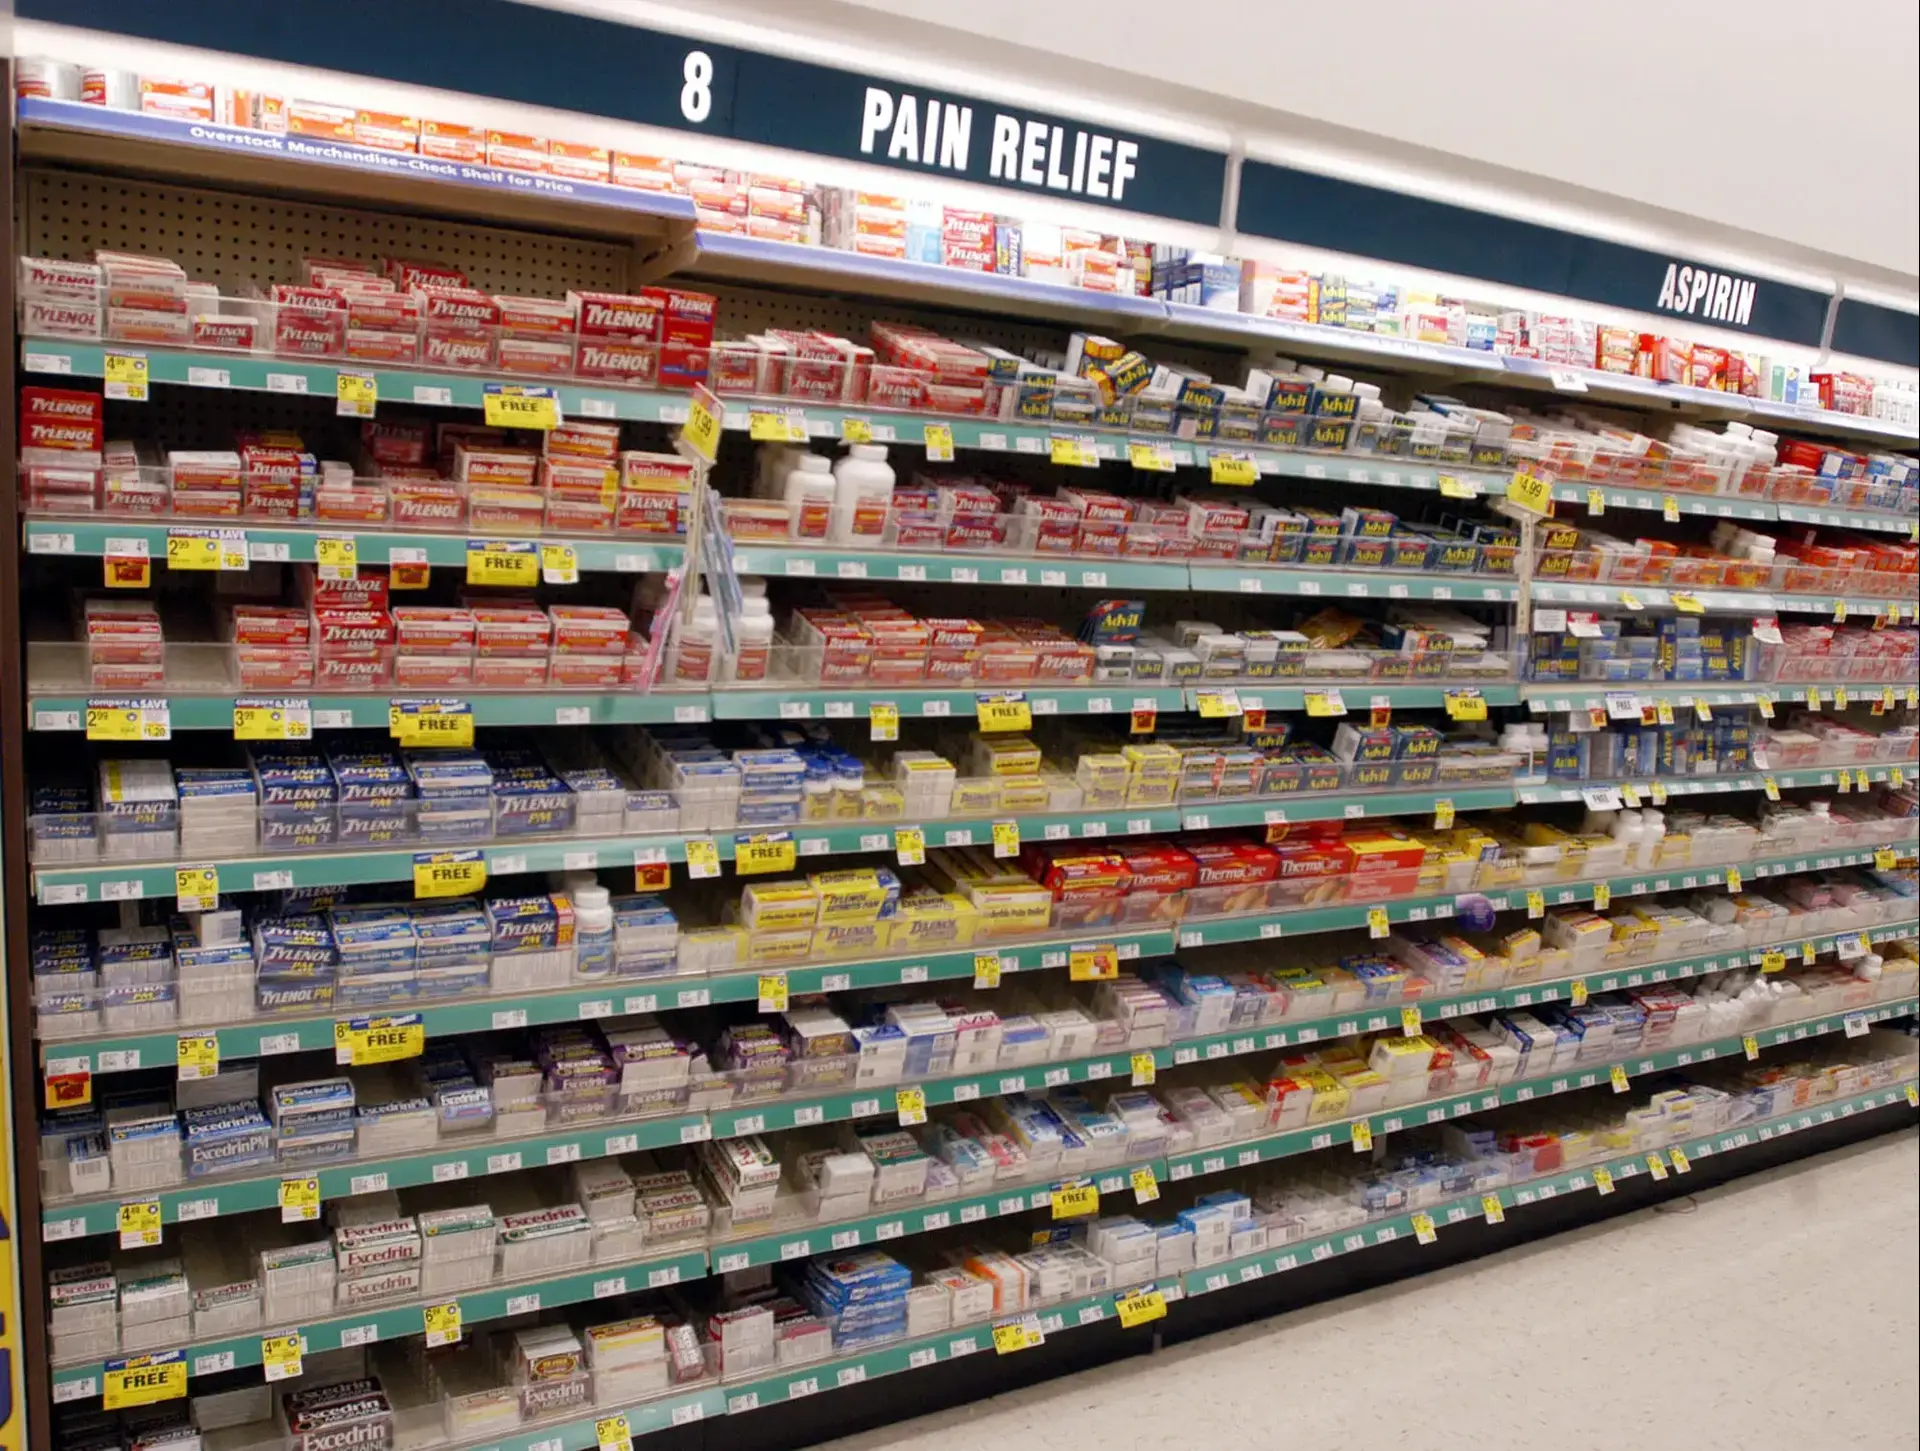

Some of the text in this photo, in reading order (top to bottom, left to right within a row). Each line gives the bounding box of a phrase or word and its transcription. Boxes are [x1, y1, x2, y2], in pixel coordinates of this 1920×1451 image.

[680, 50, 714, 123] 8
[860, 87, 1139, 201] PAIN RELIEF
[190, 126, 283, 150] Overstock
[461, 168, 504, 184] Shelf
[507, 172, 532, 187] for
[535, 178, 575, 194] Price
[1657, 263, 1758, 325] ASPIRIN
[432, 299, 492, 319] TYLENOL
[668, 294, 714, 313] TYLENOL
[31, 307, 96, 326] TYLENOL
[586, 304, 654, 330] TYLENOL
[281, 325, 336, 343] TYLENOL
[427, 339, 488, 359] TYLENOL
[581, 347, 649, 371] TYLENOL
[31, 398, 95, 415] TYLENOL
[500, 400, 539, 412] FREE
[1276, 392, 1308, 409] Advil
[1319, 398, 1355, 414] Advil
[31, 425, 95, 442] TYLENOL
[1266, 430, 1298, 445] Advil
[1313, 426, 1347, 442] Advil
[252, 461, 297, 477] TYLENOL
[629, 464, 672, 478] Aspirin
[399, 501, 460, 518] TYLENOL
[624, 494, 676, 510] TYLENOL
[219, 529, 247, 540] SAVE
[1364, 521, 1392, 533] Advil
[484, 557, 524, 569] FREE
[485, 557, 523, 569] FREE
[1444, 548, 1476, 561] Advil
[1101, 614, 1139, 628] Advil
[324, 624, 388, 641] TYLENOL
[323, 659, 384, 676] TYLENOL
[141, 700, 168, 709] SAVE
[284, 700, 309, 709] SAVE
[991, 706, 1019, 717] FREE
[419, 719, 459, 730] FREE
[1408, 738, 1438, 753] Advil
[266, 787, 333, 810] TYLENOL PM
[341, 784, 407, 807] TYLENOL PM
[502, 795, 569, 812] TYLENOL
[110, 803, 169, 815] TYLENOL
[268, 821, 333, 837] TYLENOL
[341, 818, 407, 833] TYLENOL
[750, 846, 783, 859] FREE
[433, 868, 472, 880] FREE
[1200, 865, 1266, 882] ThermaCare
[1281, 858, 1343, 874] ThermaCare
[498, 921, 554, 938] TYLENOL
[268, 947, 331, 962] TYLENOL
[261, 985, 332, 1006] TYLENOL PM
[367, 1032, 407, 1047] FREE
[1061, 1193, 1088, 1206] FREE
[503, 1206, 578, 1229] Excedrin
[343, 1221, 410, 1238] Excedrin
[348, 1246, 413, 1265] Excedrin
[56, 1281, 111, 1296] Excedrin
[348, 1275, 412, 1296] Excedrin
[1127, 1299, 1153, 1313] FREE
[123, 1371, 168, 1389] FREE
[522, 1382, 584, 1406] Excedrin
[303, 1423, 385, 1451] Excedrin
